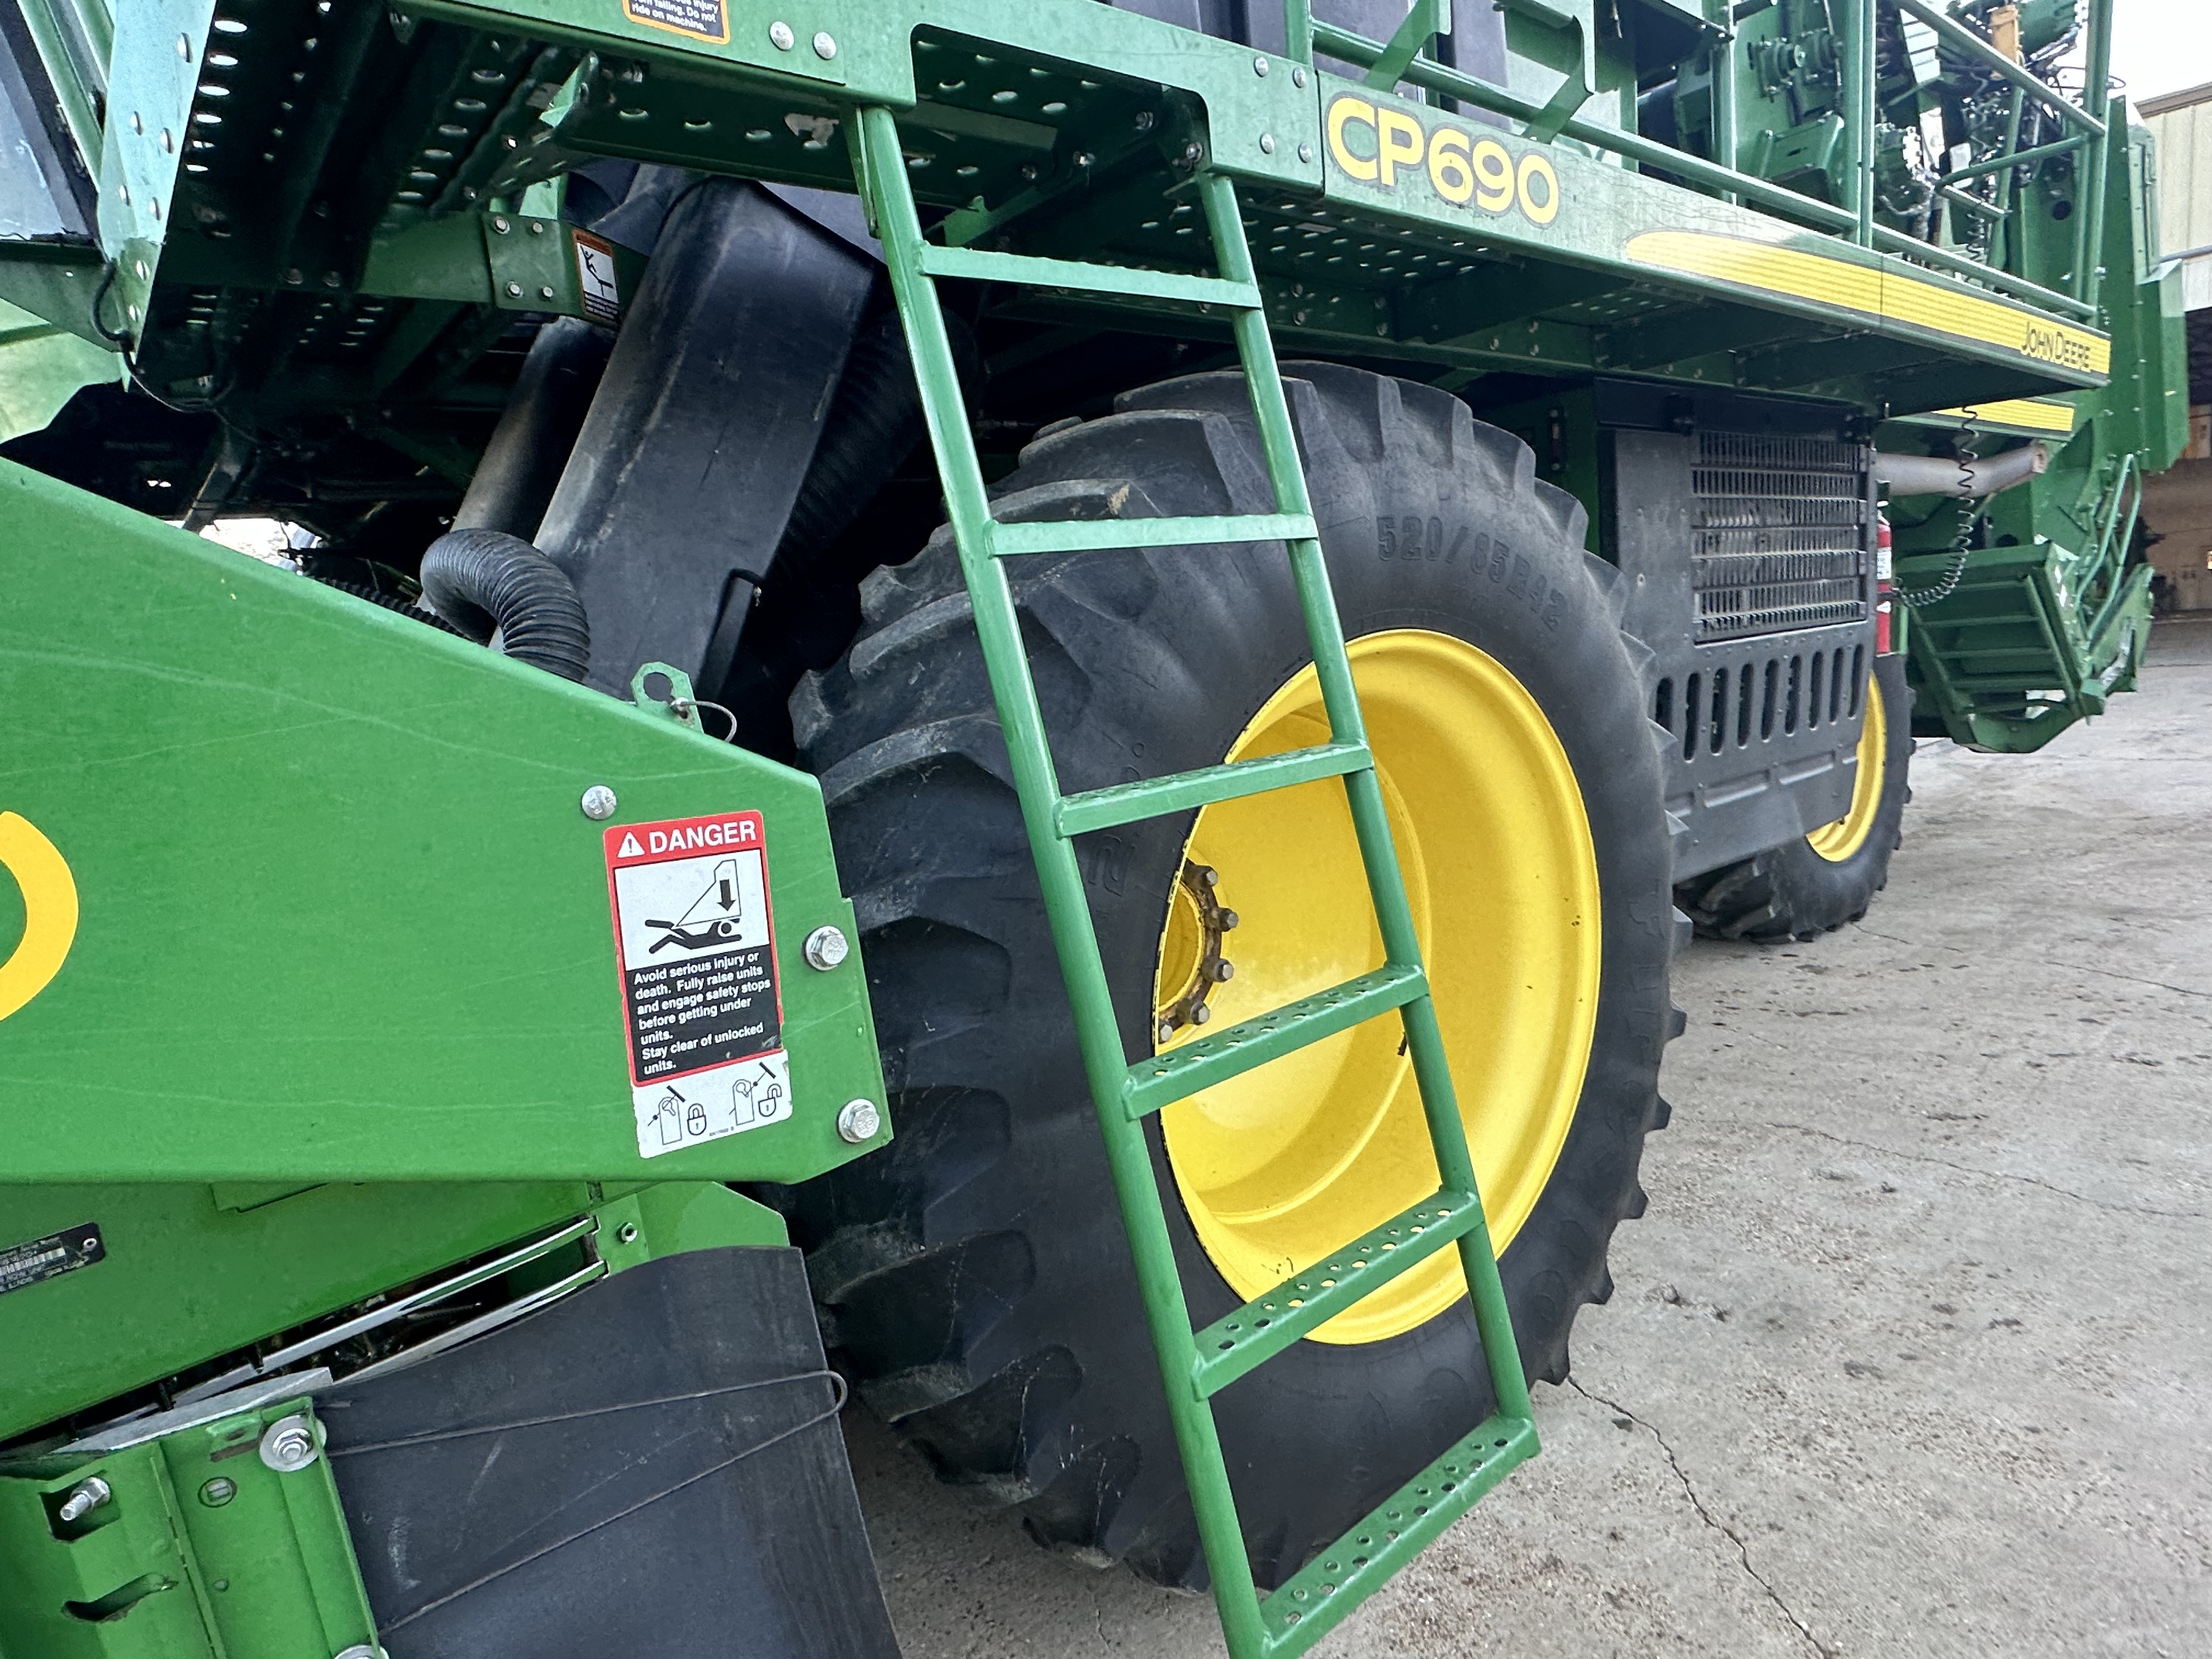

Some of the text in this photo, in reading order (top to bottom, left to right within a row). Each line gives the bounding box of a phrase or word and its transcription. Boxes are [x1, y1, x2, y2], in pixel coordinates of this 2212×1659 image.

[632, 3, 651, 16] ride
[652, 9, 665, 19] on
[666, 13, 708, 32] machine.
[686, 7, 699, 18] Do
[702, 13, 716, 22] not
[1327, 97, 1559, 225] CP690
[2021, 321, 2091, 370] JOHN DEERE
[648, 819, 757, 854] DANGER
[634, 952, 759, 985] Avoid serious injury or
[635, 966, 763, 1000] death. Fully raise units
[637, 979, 771, 1015] and engage safety stops
[639, 997, 752, 1030] before getting under
[641, 1031, 673, 1045] units.
[642, 1022, 763, 1060] Stay clear of unlocked
[644, 1060, 676, 1075] units.
